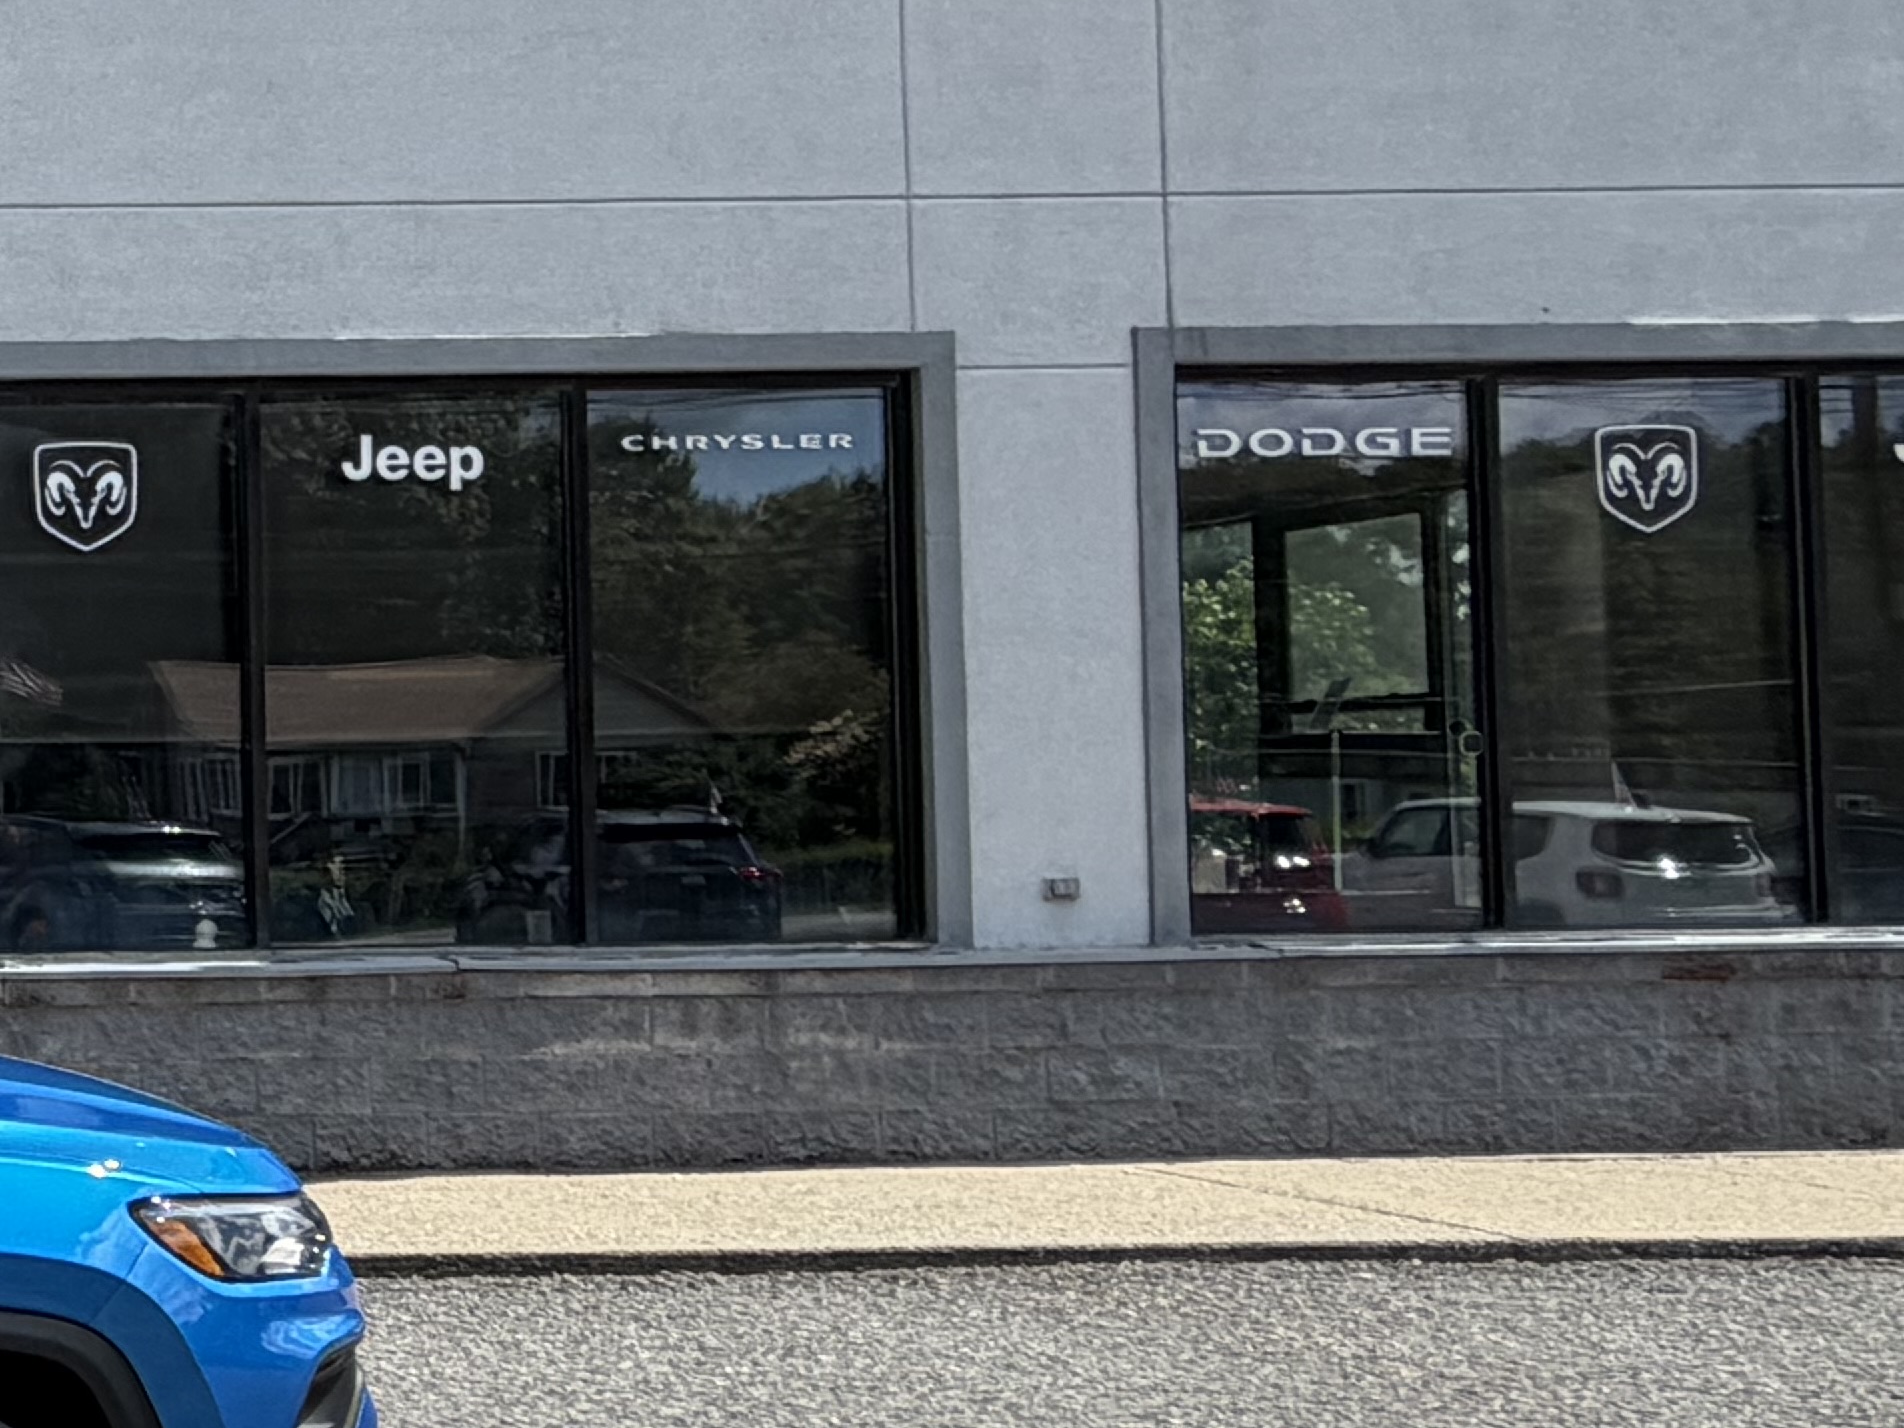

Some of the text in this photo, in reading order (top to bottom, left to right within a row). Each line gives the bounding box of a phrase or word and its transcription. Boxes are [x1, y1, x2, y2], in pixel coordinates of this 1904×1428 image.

[620, 433, 854, 451] CHRYSLER
[1196, 427, 1452, 458] DODGE
[340, 433, 484, 492] Jeep
